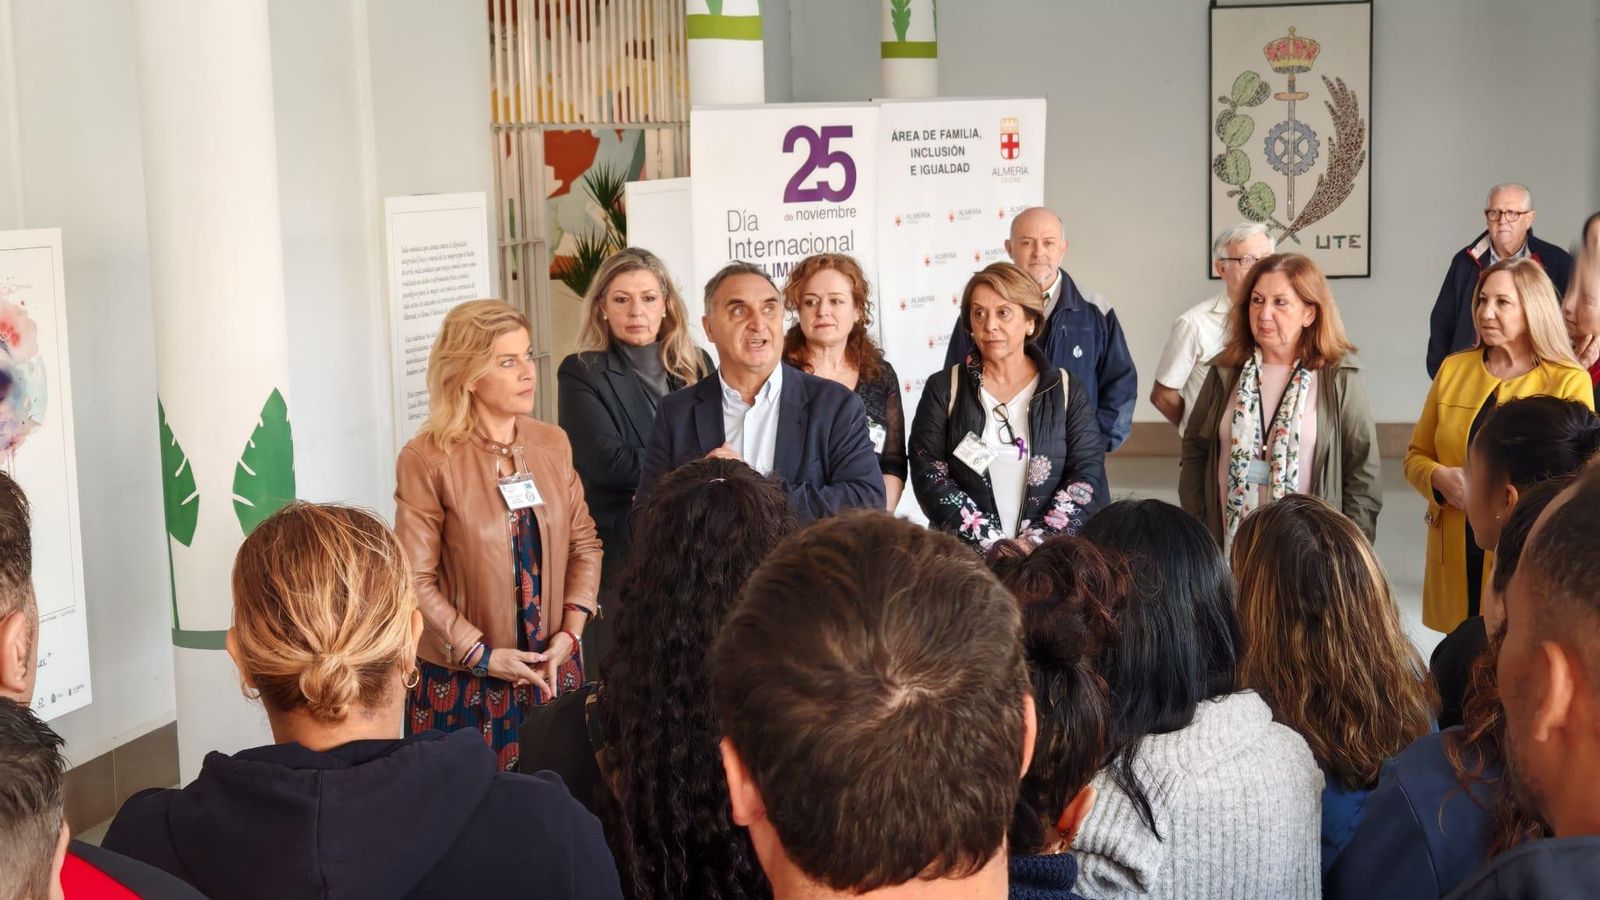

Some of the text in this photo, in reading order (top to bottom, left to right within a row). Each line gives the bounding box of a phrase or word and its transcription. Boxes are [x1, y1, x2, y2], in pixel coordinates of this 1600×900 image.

[891, 127, 982, 142] ÁREA DE FAMILIA,
[910, 145, 966, 158] INCLUSIÓN
[782, 125, 857, 204] 25
[910, 162, 970, 176] E IGUALDAD
[992, 164, 1029, 177] ALMERÍA
[727, 208, 759, 232] Día
[795, 205, 857, 221] noviembre
[728, 229, 854, 260] Internacional
[1316, 234, 1361, 249] UTE
